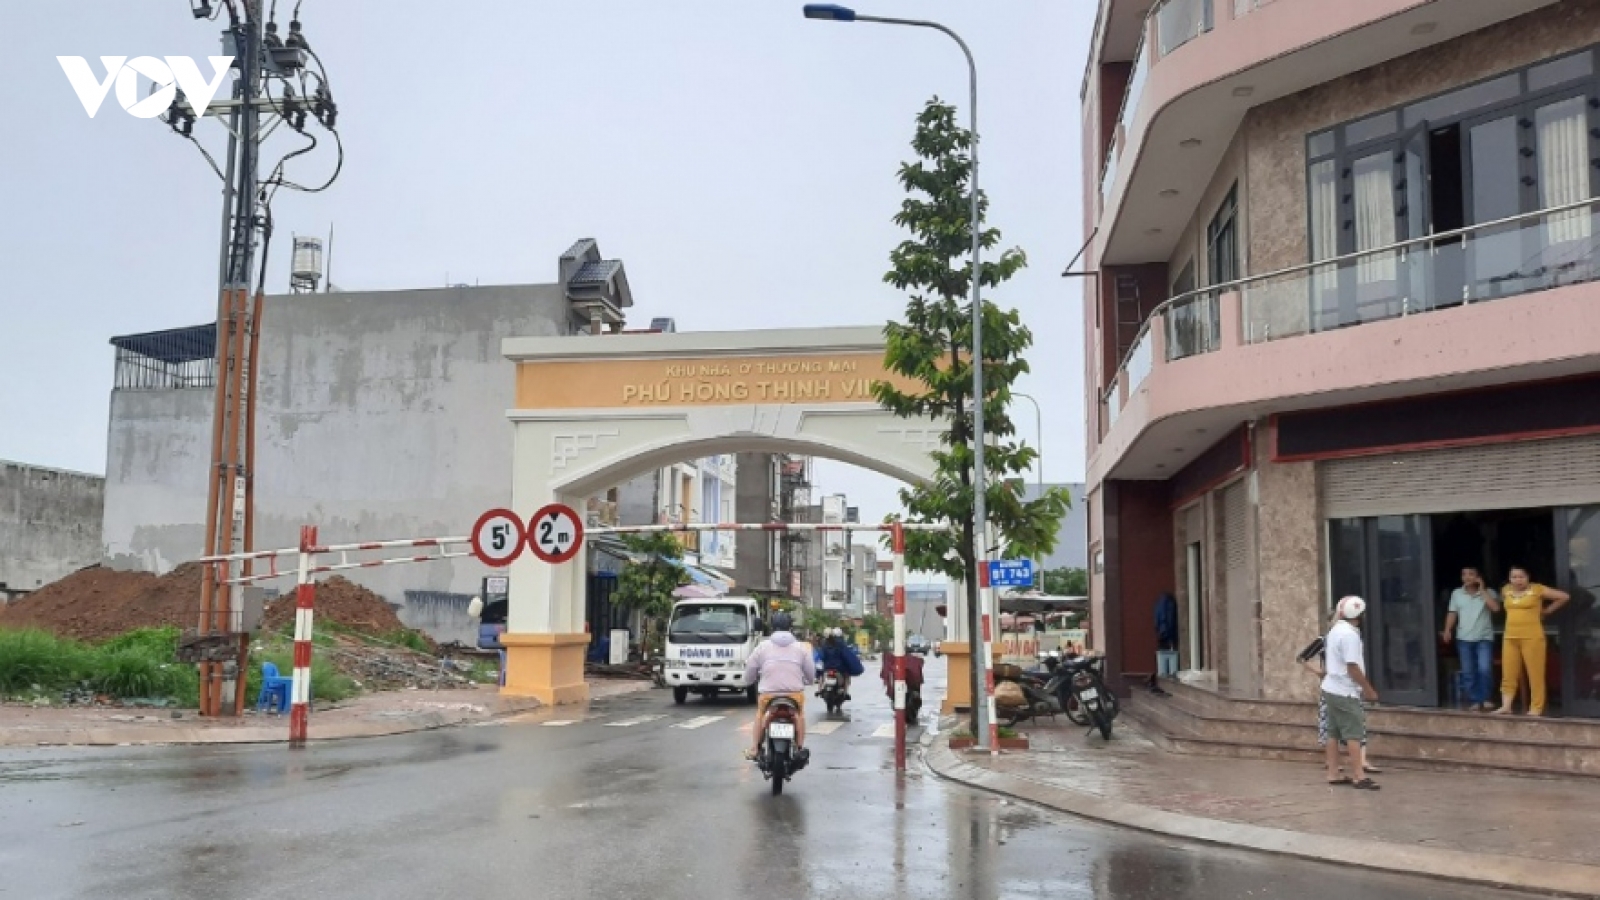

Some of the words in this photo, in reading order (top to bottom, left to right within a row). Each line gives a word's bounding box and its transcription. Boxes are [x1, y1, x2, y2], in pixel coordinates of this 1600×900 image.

[666, 364, 696, 377] KHU
[623, 379, 672, 403] PHÚ
[757, 380, 831, 403] THỊNH
[1009, 568, 1030, 579] 743
